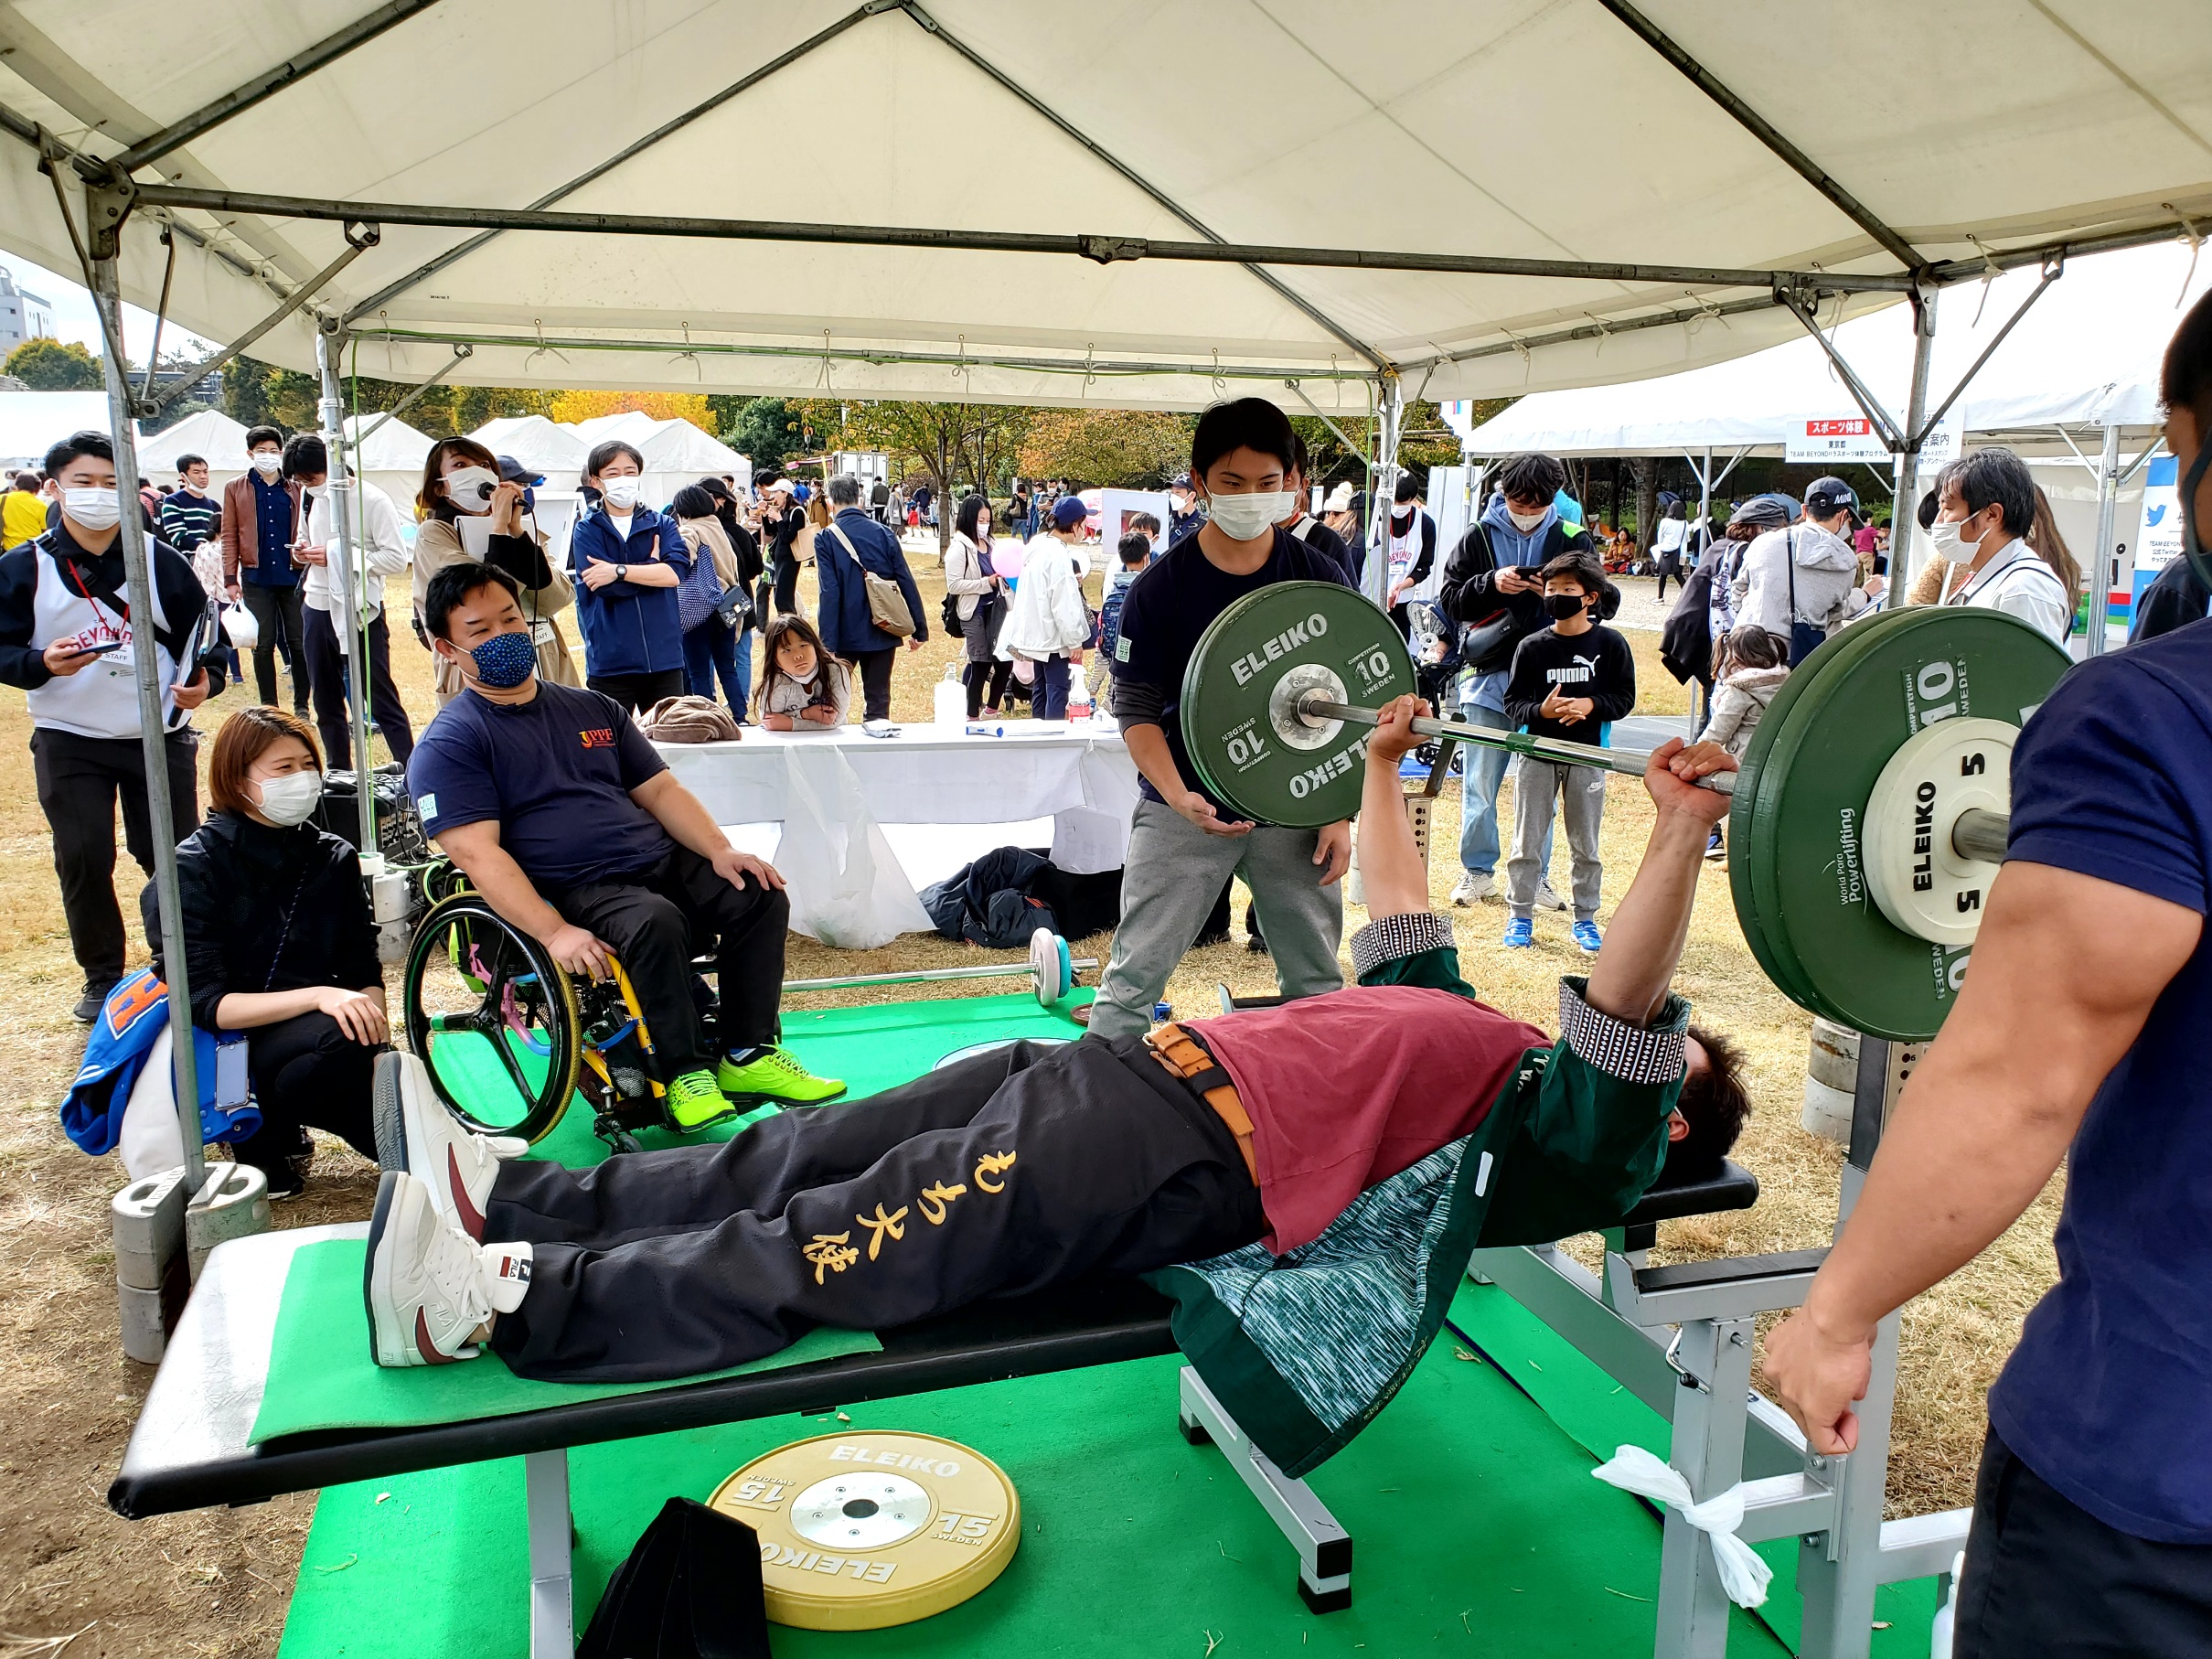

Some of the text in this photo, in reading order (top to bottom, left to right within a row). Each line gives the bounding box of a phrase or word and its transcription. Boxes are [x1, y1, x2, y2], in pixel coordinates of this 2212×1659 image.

[1812, 421, 1864, 433] スポーツ体験
[1828, 441, 1846, 449] 東京都
[536, 632, 549, 641] TAFF
[1230, 613, 1328, 686] ELEIKO
[105, 653, 128, 661] STAFF
[1354, 651, 1390, 686] 10
[1362, 673, 1396, 698] SWEDEN
[1546, 667, 1589, 683] PUMA
[1957, 656, 1970, 716] WEDEN
[1905, 673, 1918, 734] OMPETITION
[1917, 661, 1958, 726] 10
[1221, 717, 1256, 743] SWEDEN
[1226, 729, 1265, 765] 10
[1289, 727, 1375, 798] LEIKO
[1961, 753, 1985, 776] 5
[1913, 782, 1936, 891] ELEIKO
[1840, 808, 1862, 903] Powerlifting
[1836, 853, 1849, 905] World Para
[1957, 889, 1980, 913] 5
[1931, 944, 1946, 1000] WEDEN
[1910, 1054, 1917, 1062] 6
[803, 1150, 1017, 1286] もち大使
[509, 1258, 519, 1278] FILA
[431, 1300, 454, 1327] FILA
[828, 1444, 961, 1478] ELEIKO
[732, 1481, 785, 1504] 15
[747, 1475, 796, 1486] SWEDEN
[939, 1514, 993, 1538] 15
[931, 1532, 983, 1547] SWEDEN
